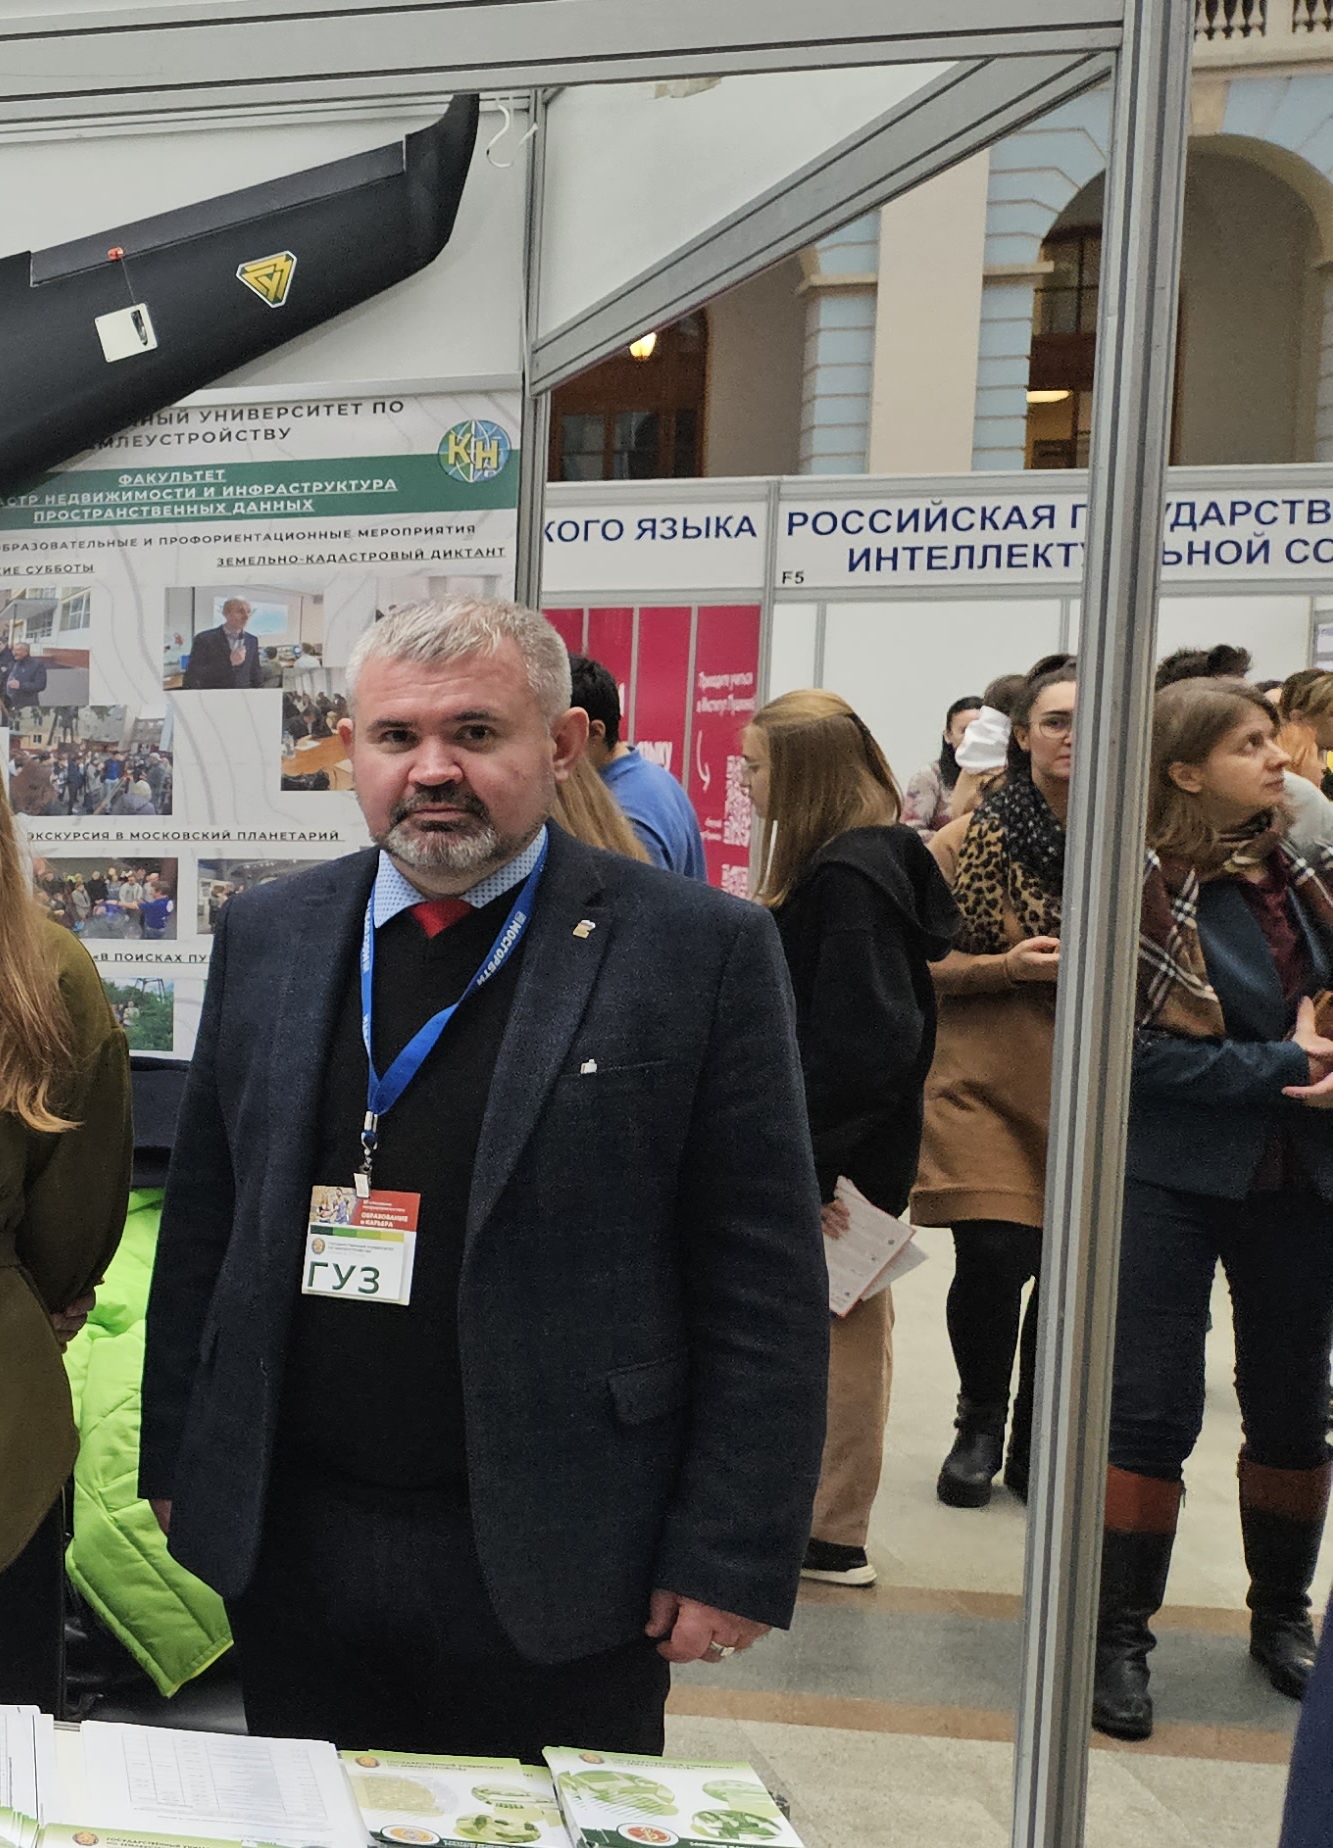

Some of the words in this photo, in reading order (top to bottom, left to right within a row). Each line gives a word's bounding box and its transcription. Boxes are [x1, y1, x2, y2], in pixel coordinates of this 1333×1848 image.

[200, 402, 364, 424] УНИВЕРСИТЕТ
[373, 400, 405, 415] ПО
[118, 468, 226, 486] ФАКУЛЬТЕТ
[45, 486, 196, 505] НЕДВИЖИМОСТИ
[204, 486, 215, 498] И
[222, 478, 398, 498] ИНФРАСТРУКТУРА
[34, 502, 226, 523] ПРОСТРАНСТВЕННЫХ
[232, 498, 314, 516] ДАННЫХ
[787, 499, 1056, 536] РОССИЙСКАЯ
[144, 538, 153, 546] И
[159, 529, 351, 546] ПРОФОРИЕНТАЦИОННЫЕ
[358, 524, 476, 539] МЕРОПРИЯТИЯ
[634, 514, 757, 541] ЯЗЫКА
[217, 549, 425, 568] ЗЕМЕЛЬНО-КАДАСТРОВЫЙ
[431, 546, 506, 561] ДИКТАНТ
[26, 563, 95, 576] СУББОТЫ
[782, 570, 805, 585] F5
[116, 832, 124, 840] В
[130, 829, 231, 841] МОСКОВСКИЙ
[237, 829, 339, 841] ПЛАНЕТАРИЙ
[114, 953, 182, 963] ПОИСКАХ
[307, 1260, 381, 1295] ГУЗ
